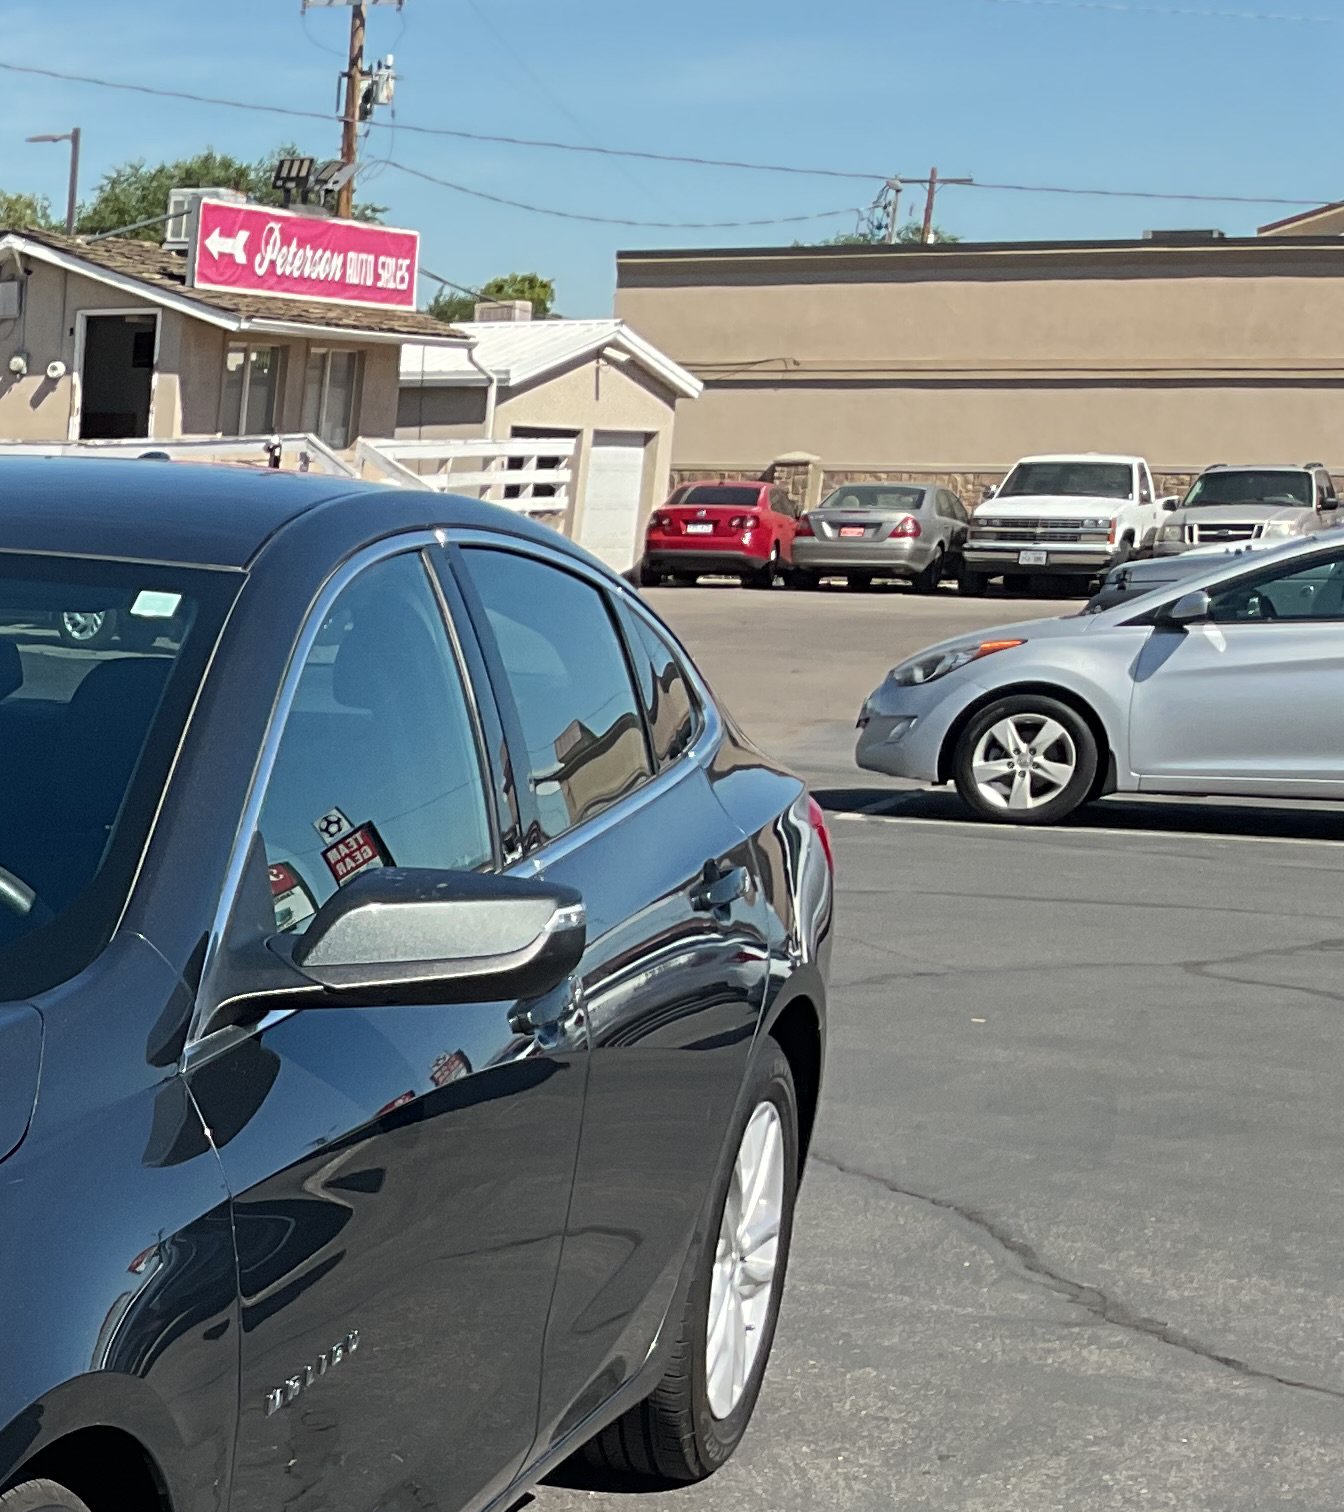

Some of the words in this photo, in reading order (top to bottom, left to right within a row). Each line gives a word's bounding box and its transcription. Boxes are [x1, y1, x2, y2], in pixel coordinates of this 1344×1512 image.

[255, 221, 345, 283] Peterson
[346, 252, 374, 287] AUTO
[376, 254, 411, 291] SALES
